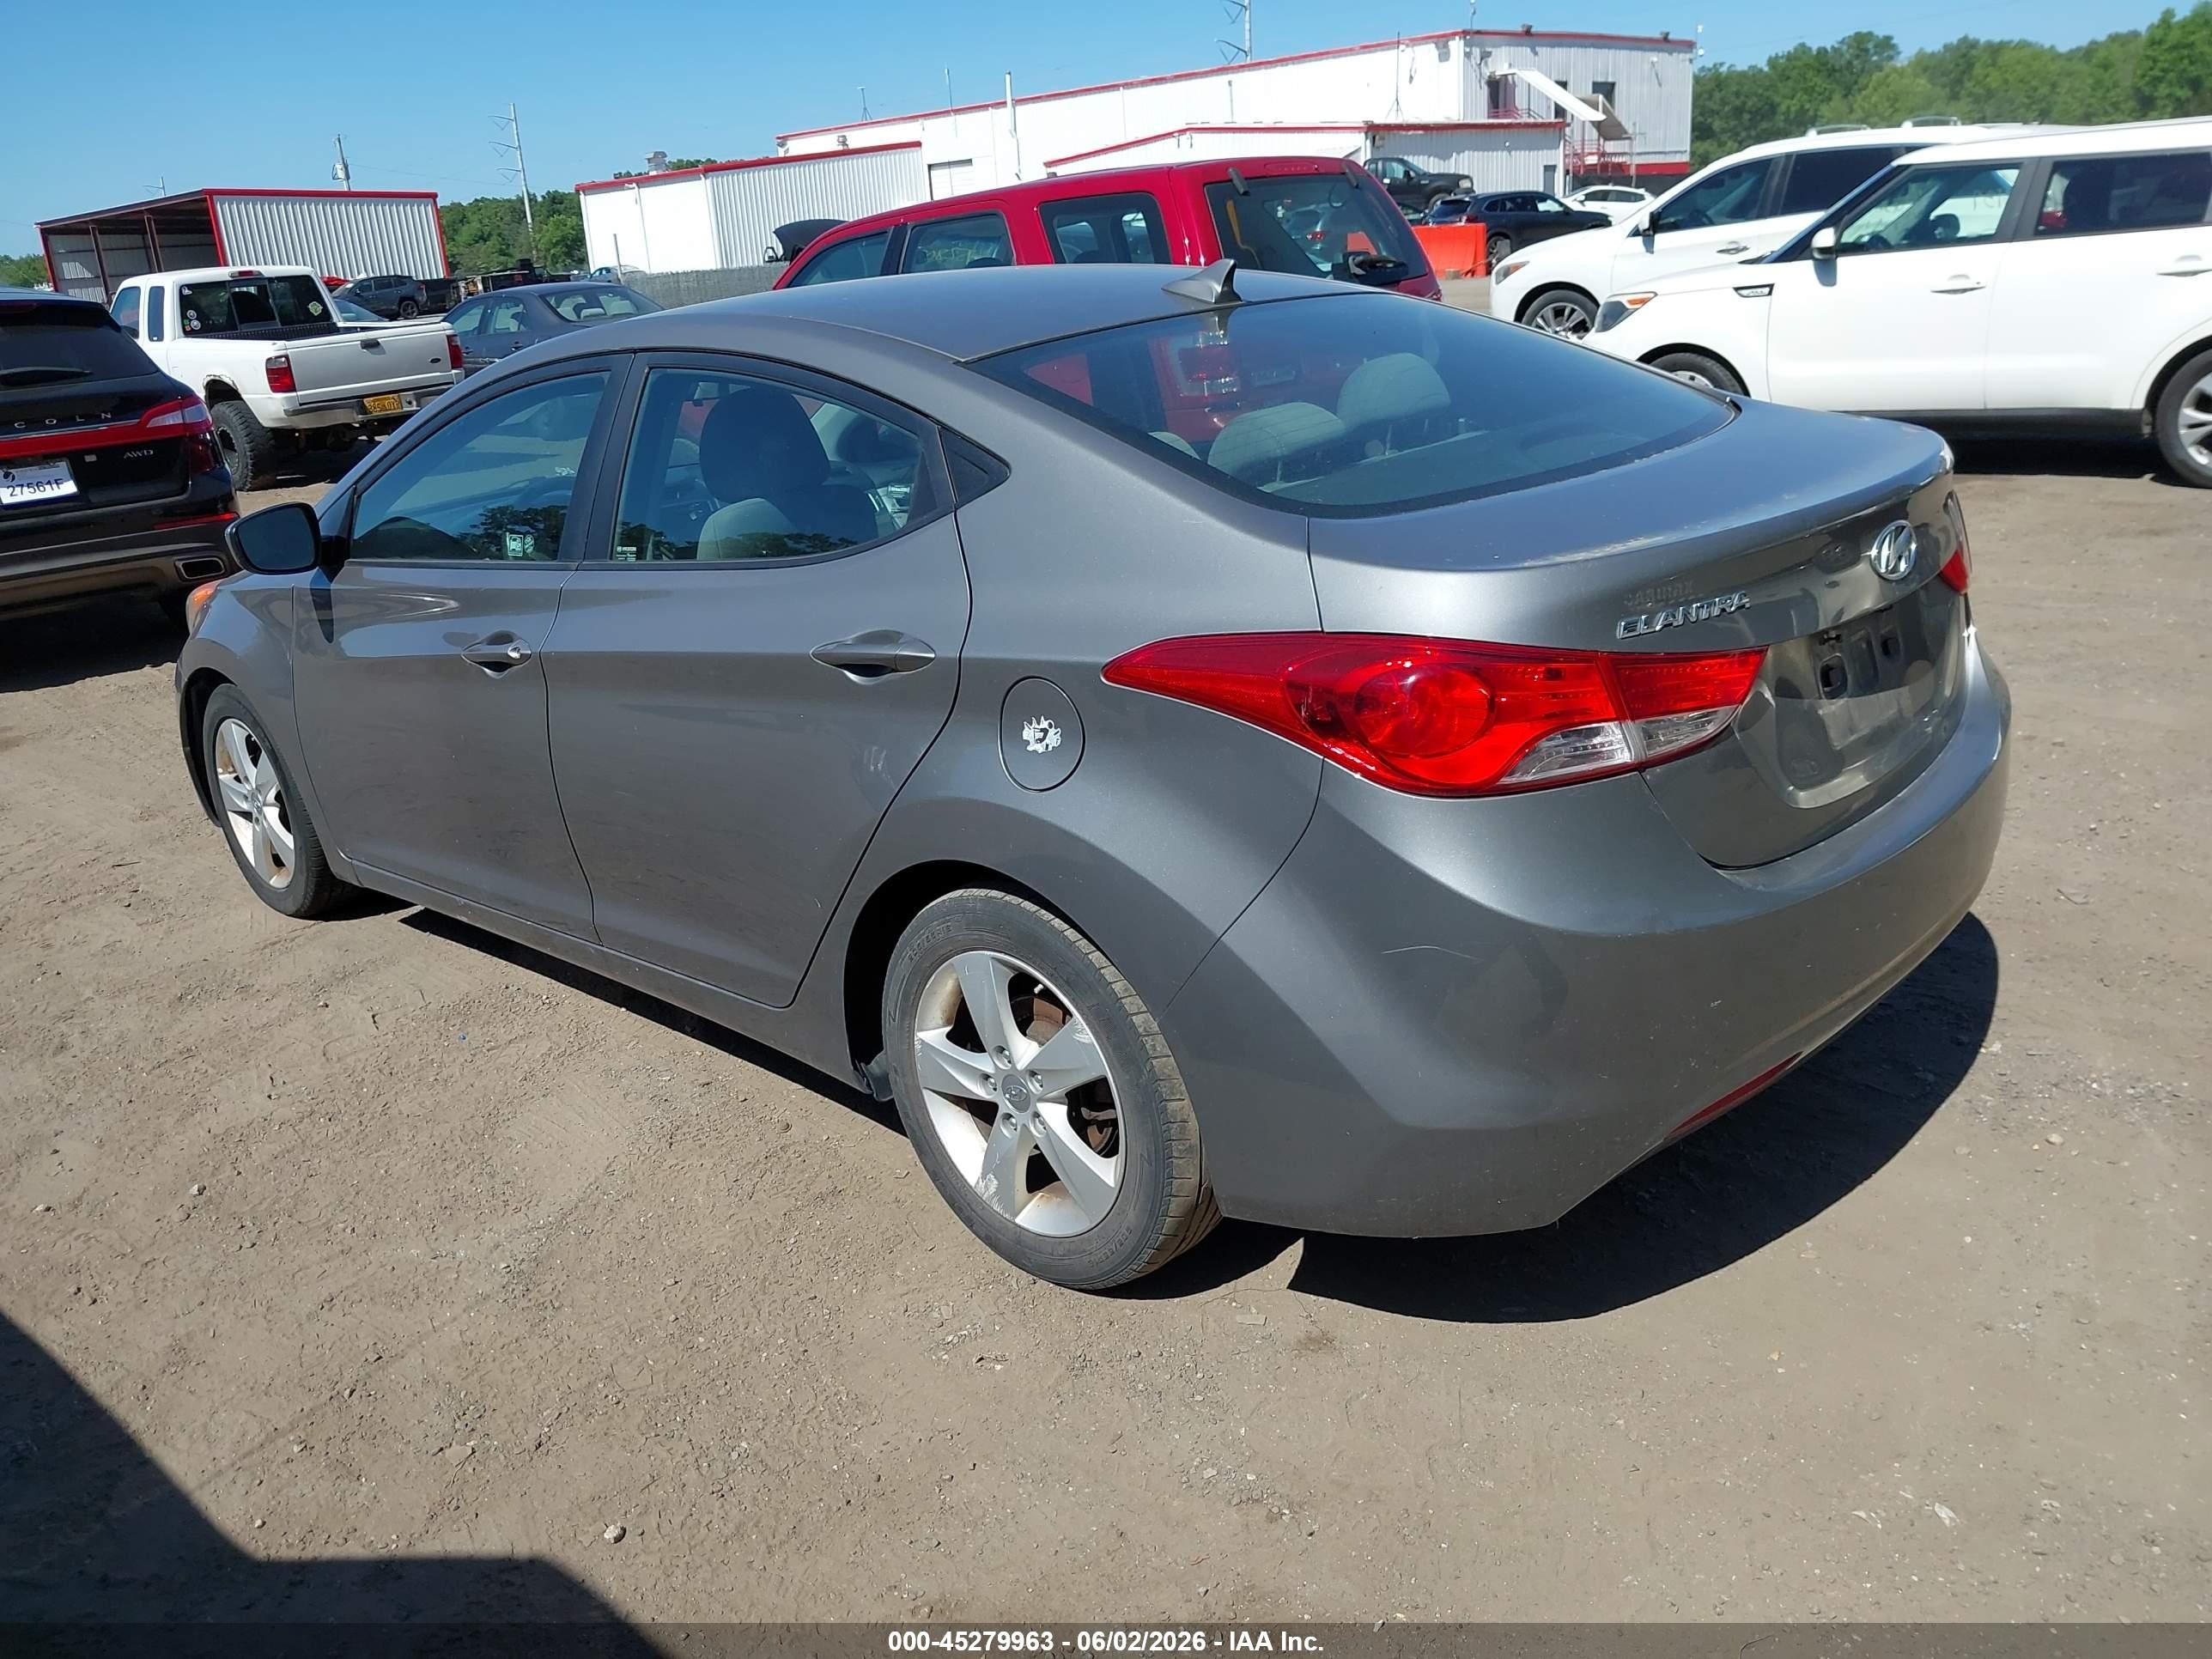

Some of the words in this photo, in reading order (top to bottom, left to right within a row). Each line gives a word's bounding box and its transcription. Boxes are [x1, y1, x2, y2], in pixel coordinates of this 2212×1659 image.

[123, 449, 154, 459] AWD
[7, 477, 64, 497] 27561F
[1616, 590, 1752, 640] ELANTRA
